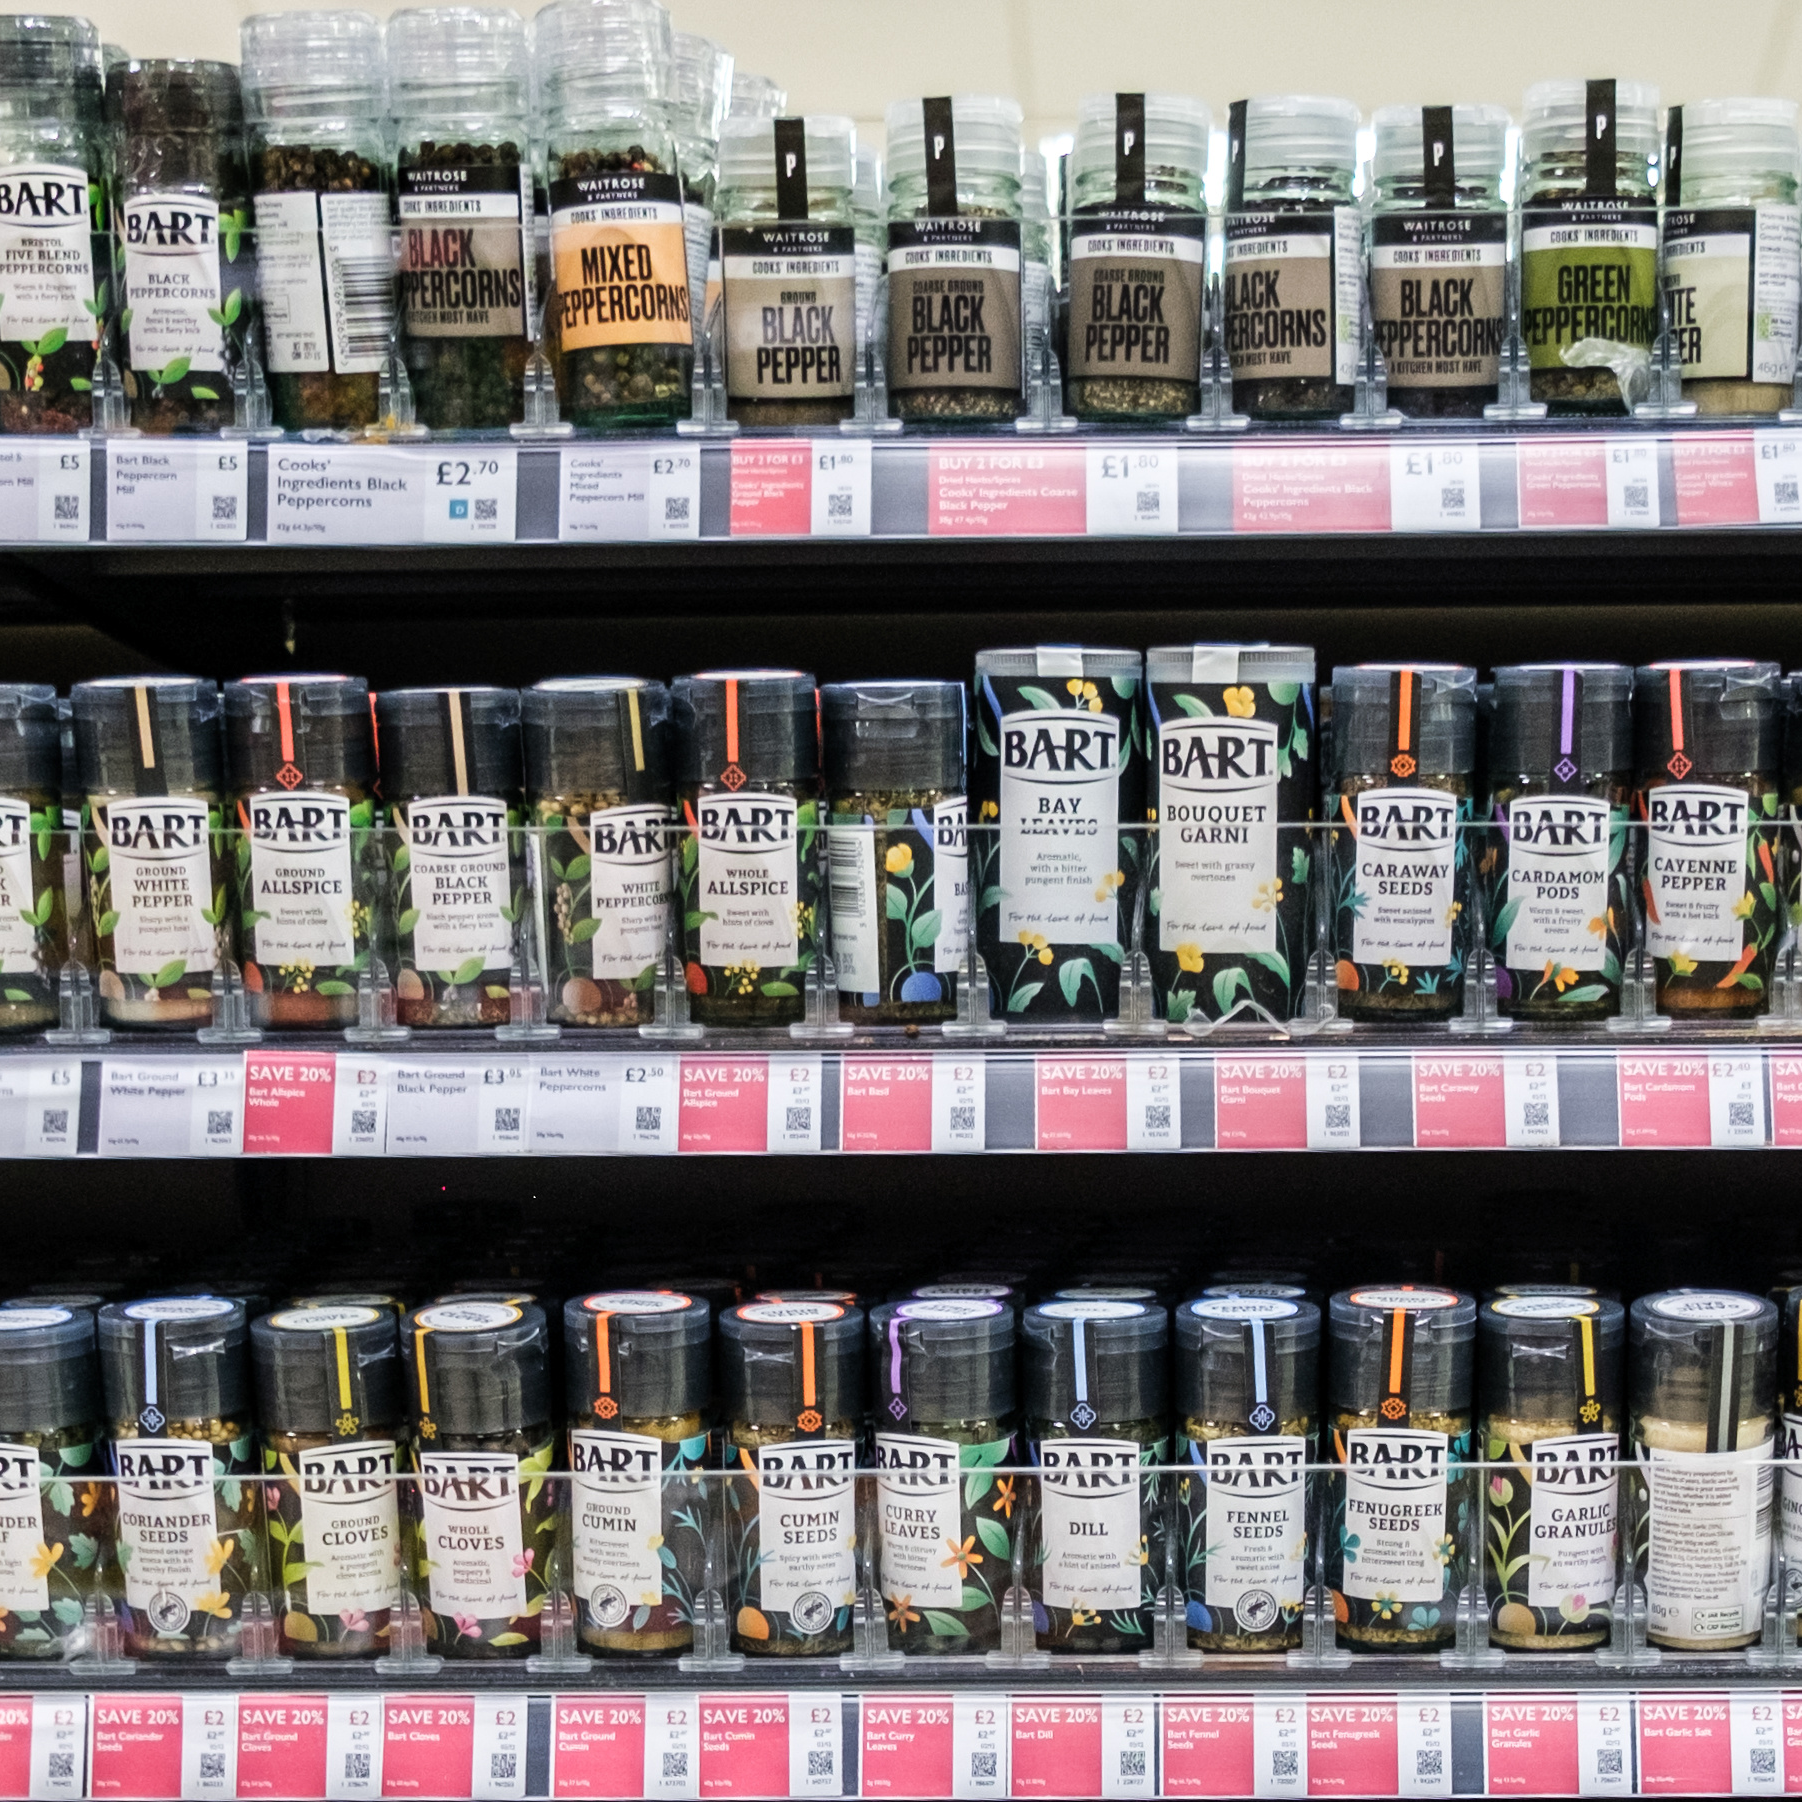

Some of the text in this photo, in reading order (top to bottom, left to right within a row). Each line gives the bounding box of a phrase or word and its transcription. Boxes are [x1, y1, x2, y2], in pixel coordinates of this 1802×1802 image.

[21, 238, 64, 248] BRISTOL
[6, 250, 80, 261] FIVE BLEND
[0, 262, 90, 274] PEPPERCORNS
[147, 273, 189, 285] BLACK
[1557, 266, 1630, 303] GREEN
[130, 285, 216, 299] PEPPERCORNS
[762, 304, 833, 344] BLACK
[757, 345, 841, 384] PEPPER
[60, 456, 80, 470] £5
[278, 477, 407, 492] Ingredients Black
[277, 494, 372, 509] Peppercorns
[1039, 798, 1081, 815] BAY
[1167, 806, 1266, 823] BOUQUET
[1181, 827, 1247, 844] GARNI
[1362, 863, 1449, 880] CARAWAY
[261, 880, 342, 895] ALLSPICE
[1379, 881, 1432, 895] SEEDS
[250, 1066, 331, 1082] SAVE 20%
[1347, 1501, 1442, 1519] FENUGREEK
[781, 1513, 840, 1528] CUMIN
[1369, 1517, 1420, 1532] SEEDS
[447, 1526, 489, 1535] WHOLE
[784, 1529, 837, 1544] SEEDS
[1070, 1523, 1108, 1536] DILL
[438, 1536, 503, 1551] CLOVES
[1015, 1708, 1098, 1724] SAVE 20%
[1016, 1729, 1053, 1738] Bart Dill
